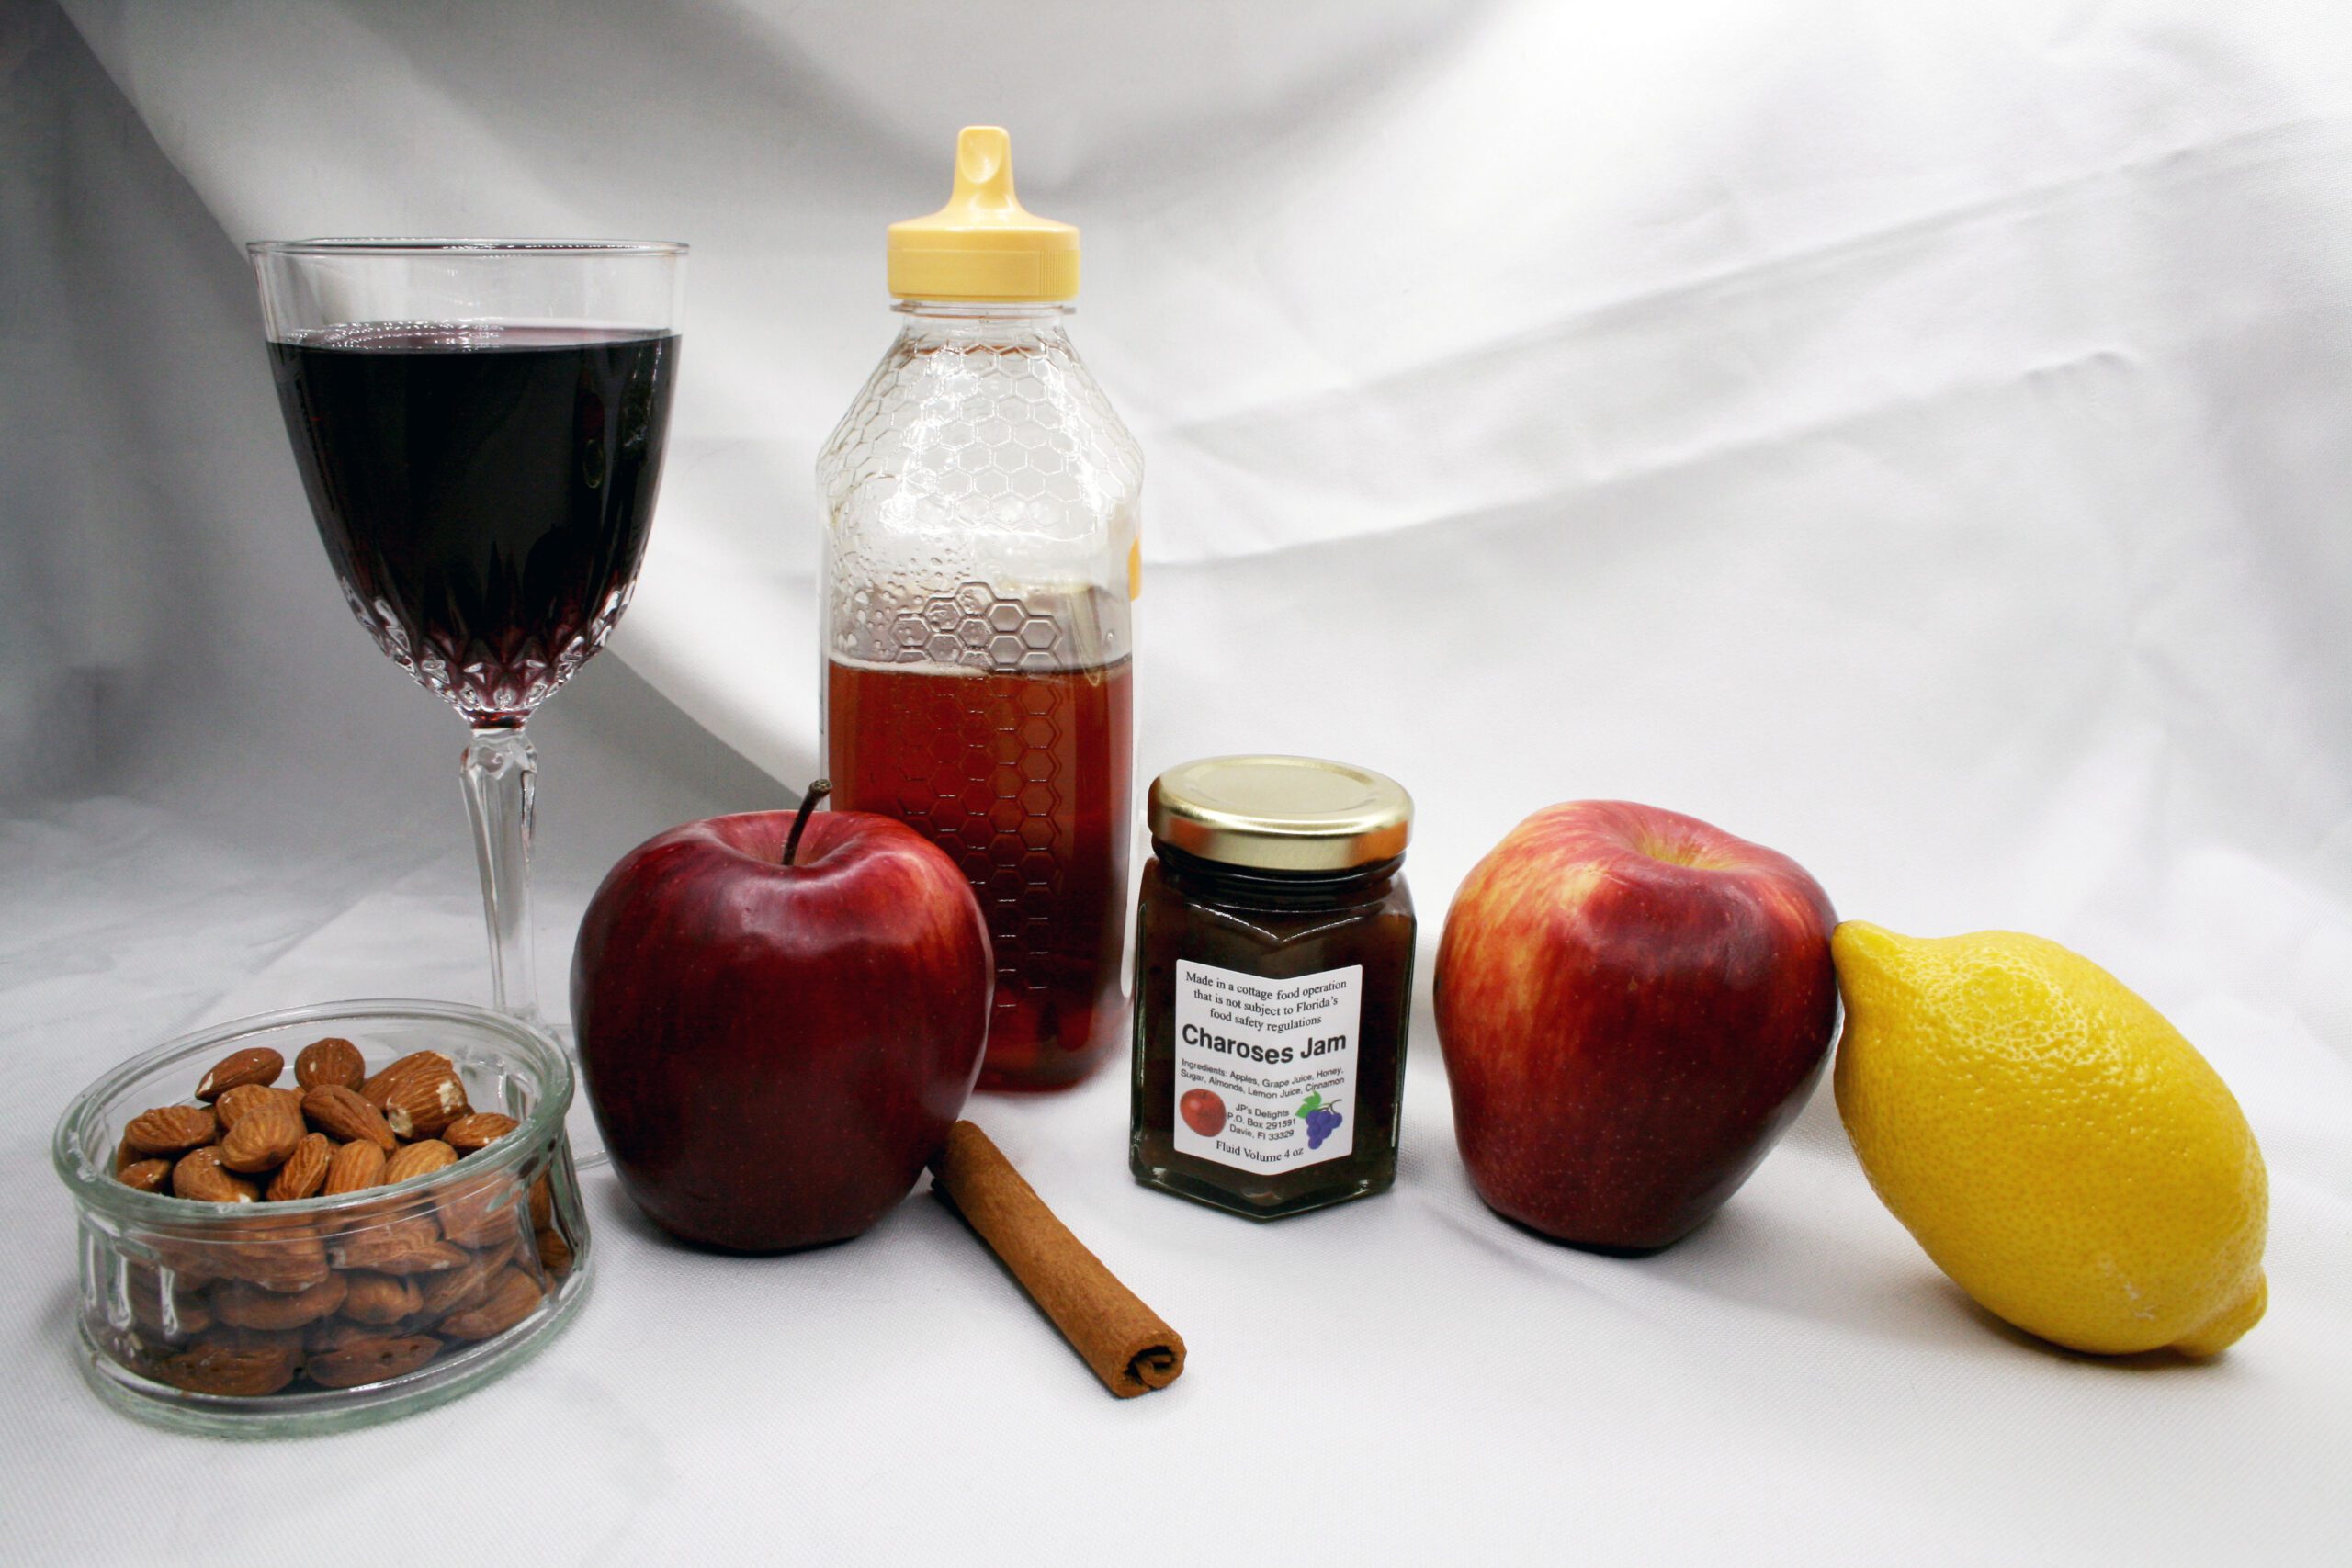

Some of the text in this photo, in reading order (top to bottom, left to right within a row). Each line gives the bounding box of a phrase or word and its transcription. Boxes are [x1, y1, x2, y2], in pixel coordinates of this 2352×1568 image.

[1186, 971, 1213, 986] Made
[1216, 978, 1226, 989] in
[1237, 986, 1272, 1000] cottage
[1277, 987, 1300, 1000] food
[1303, 981, 1347, 998] operation
[1194, 989, 1338, 1017] that is not subject to Florida's
[1210, 1009, 1322, 1033] food safety regulations
[1182, 1023, 1346, 1065] Charoses Jam
[1248, 1087, 1278, 1099] Lemon
[1306, 1077, 1345, 1091] Cinnamon
[1262, 1078, 1290, 1089] Grape
[1236, 1104, 1290, 1120] JP's Delights
[1248, 1118, 1264, 1129] Box
[1265, 1118, 1296, 1130] 291591
[1268, 1130, 1295, 1141] 33329
[1216, 1140, 1304, 1162] Fluid Volume 4 oz
